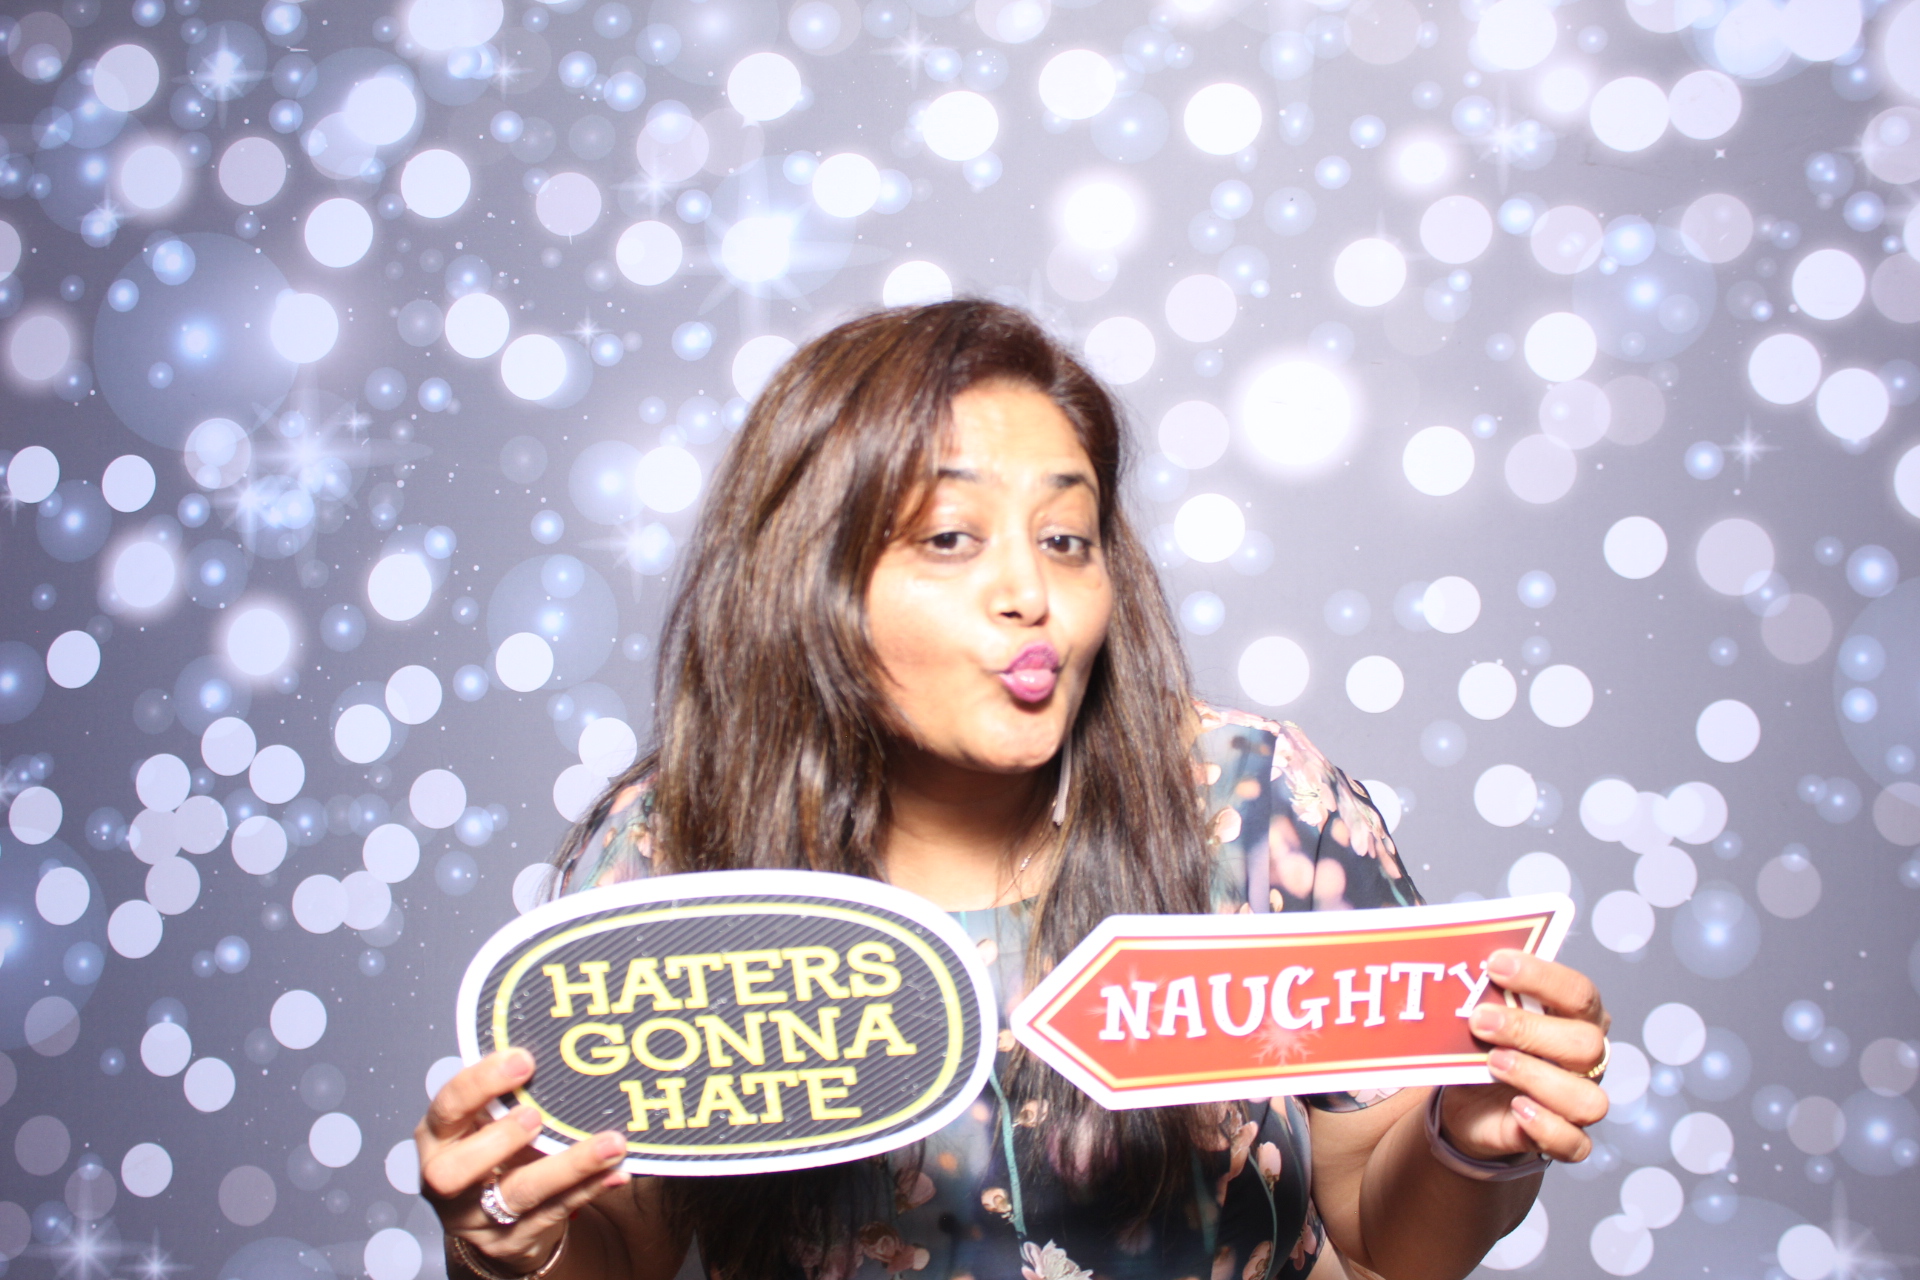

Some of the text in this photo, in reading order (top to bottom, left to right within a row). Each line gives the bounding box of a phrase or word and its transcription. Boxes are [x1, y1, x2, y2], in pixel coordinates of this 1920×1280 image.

[542, 940, 902, 1018] HATERS
[1098, 961, 1490, 1042] NAUGHTY
[559, 1003, 917, 1076] GONNA
[619, 1066, 863, 1132] HATE
